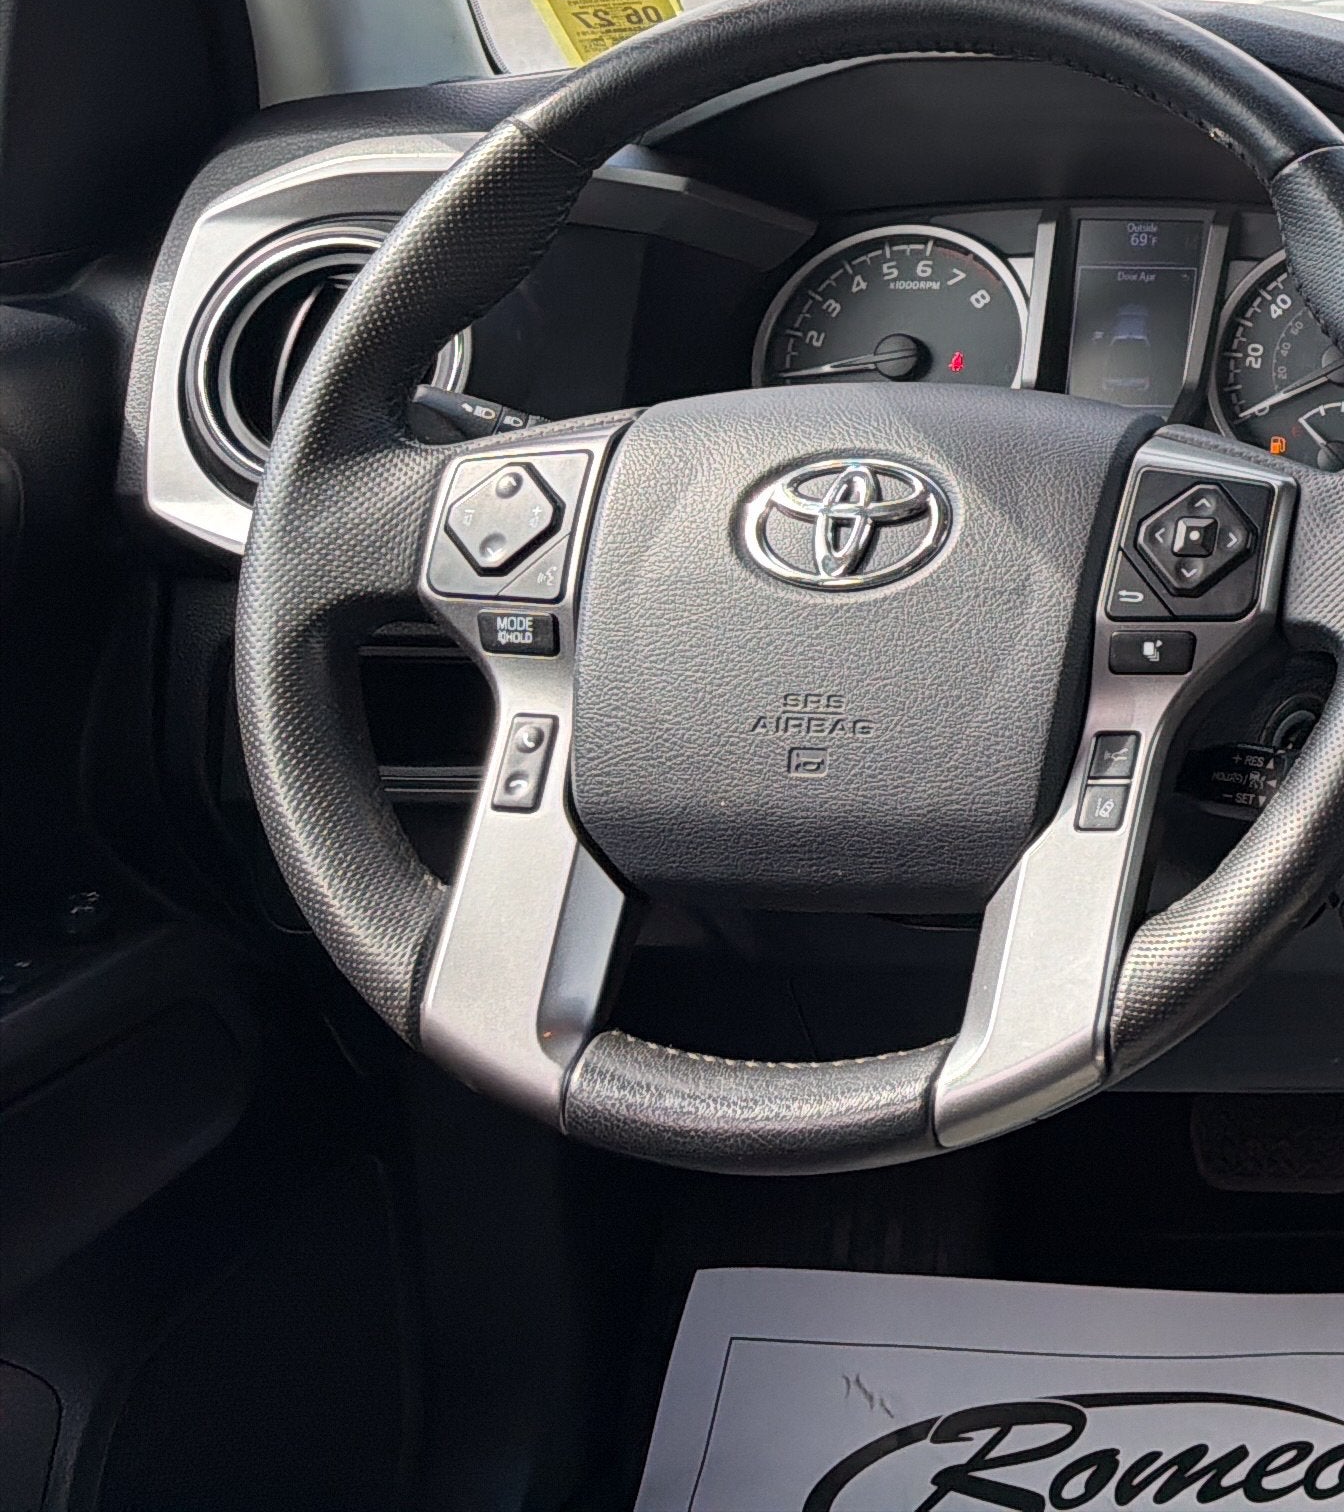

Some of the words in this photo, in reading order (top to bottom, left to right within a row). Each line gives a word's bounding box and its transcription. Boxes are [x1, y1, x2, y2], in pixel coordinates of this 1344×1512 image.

[1127, 223, 1158, 233] Outside
[882, 262, 898, 280] 5
[916, 260, 933, 277] 6
[947, 268, 966, 286] 7
[1118, 271, 1138, 281] Door
[1140, 271, 1156, 283] Ajar
[851, 274, 868, 293] 4
[970, 289, 990, 308] 8
[1270, 294, 1291, 319] 40
[822, 298, 841, 317] 3
[806, 330, 825, 347] 2
[1246, 344, 1263, 368] 20
[1280, 342, 1291, 357] 40
[1277, 366, 1288, 379] 20
[497, 616, 533, 632] MODE
[506, 633, 533, 644] HOLD
[782, 693, 844, 709] SRS
[750, 717, 874, 736] AIRBAG
[1245, 756, 1265, 766] RES
[1235, 793, 1255, 804] SET
